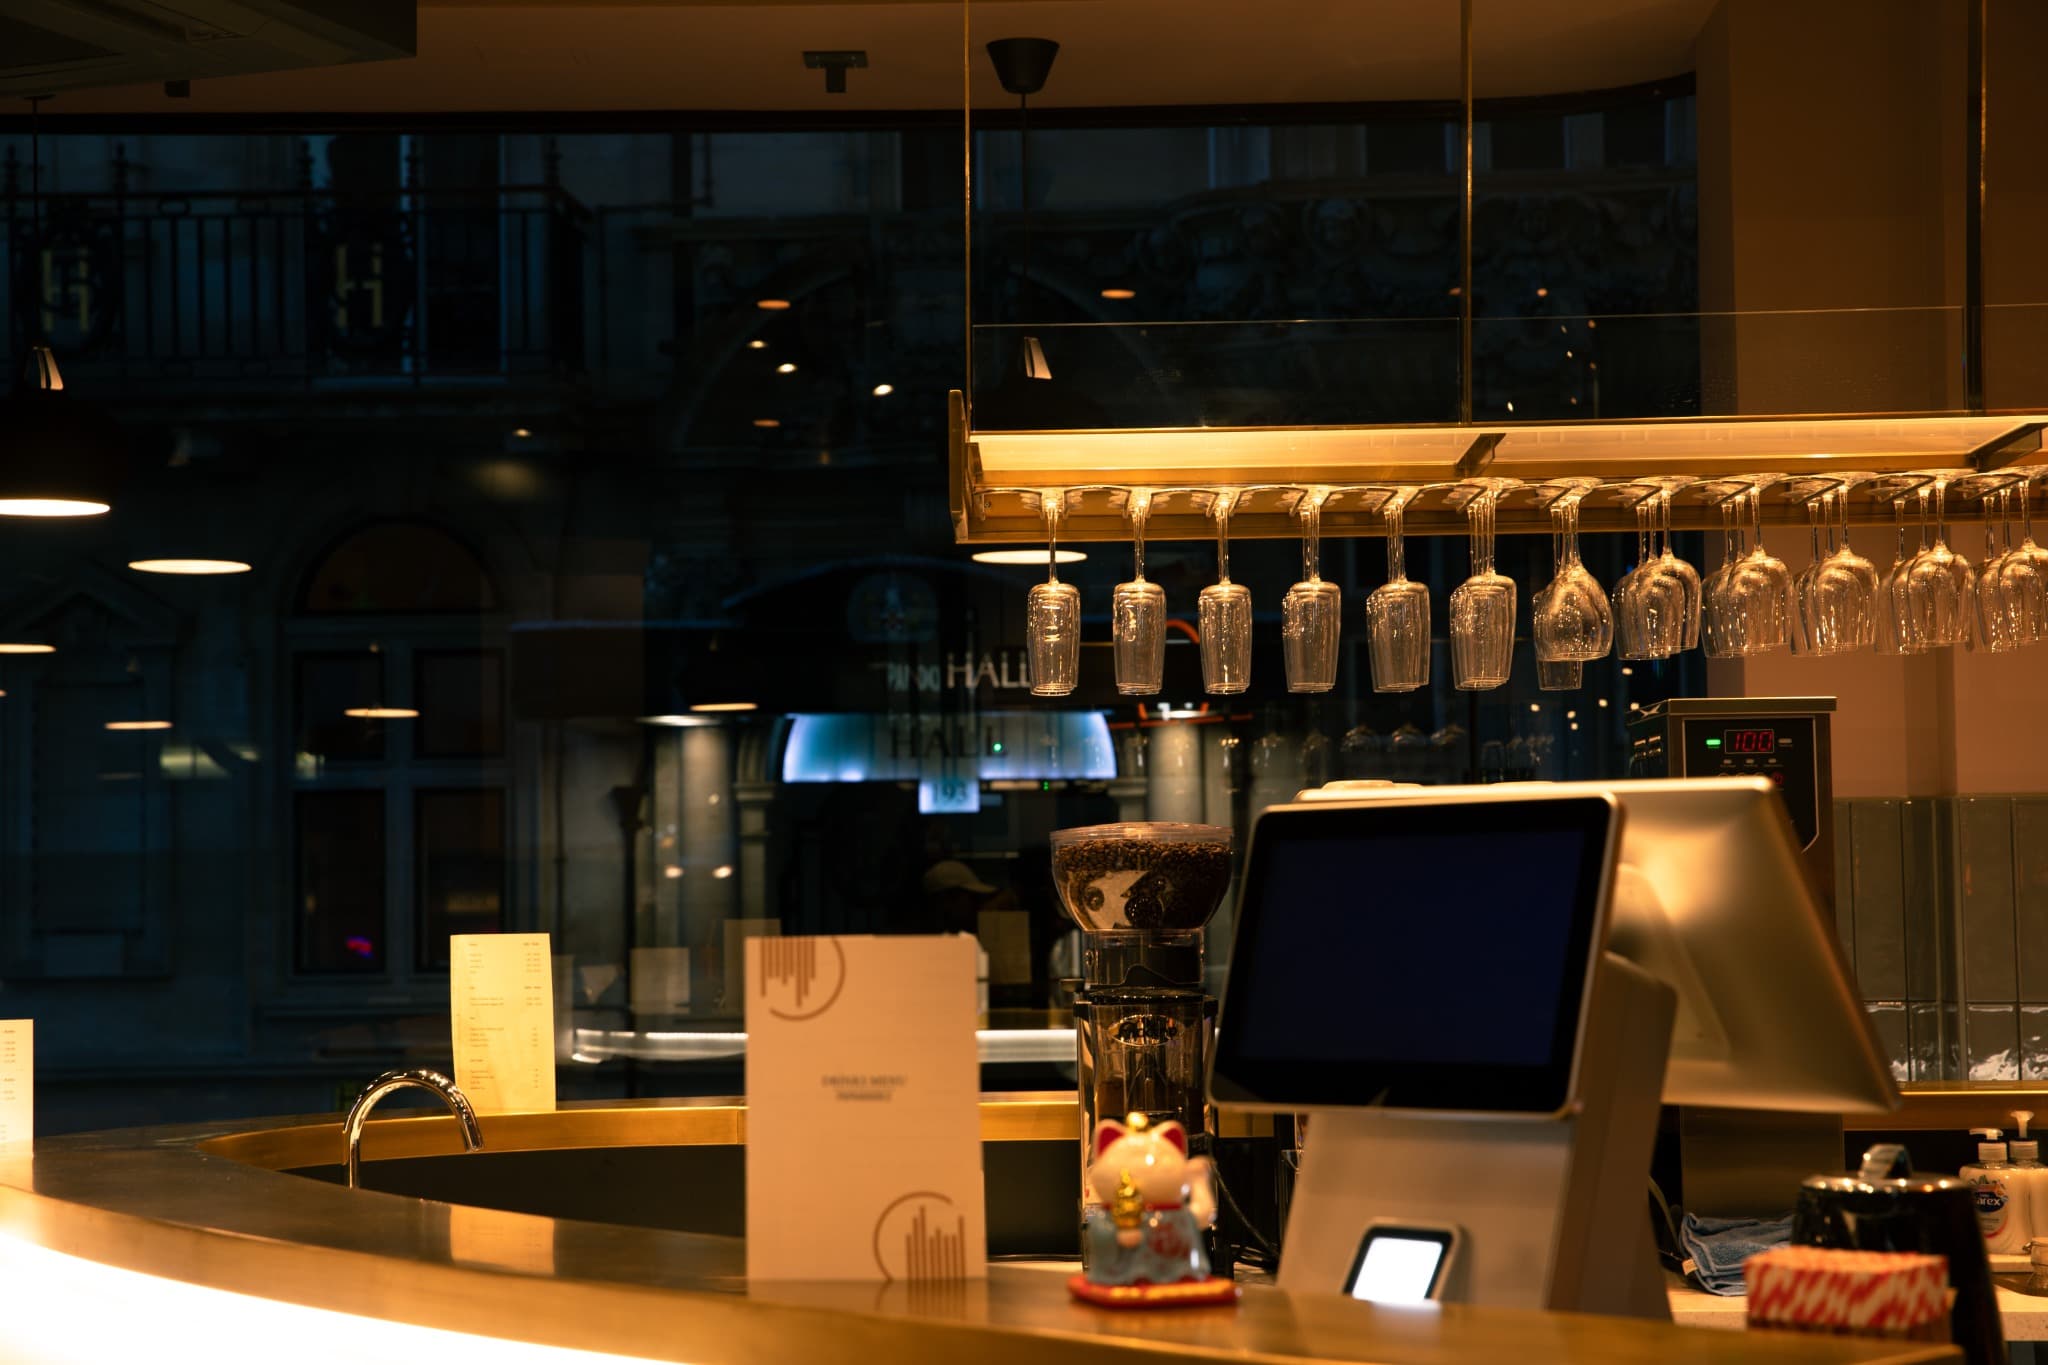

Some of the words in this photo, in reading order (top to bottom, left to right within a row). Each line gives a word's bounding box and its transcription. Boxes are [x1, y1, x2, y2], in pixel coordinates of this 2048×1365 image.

[945, 651, 1031, 689] HALL
[891, 724, 1007, 758] HALL
[1735, 730, 1773, 752] 100
